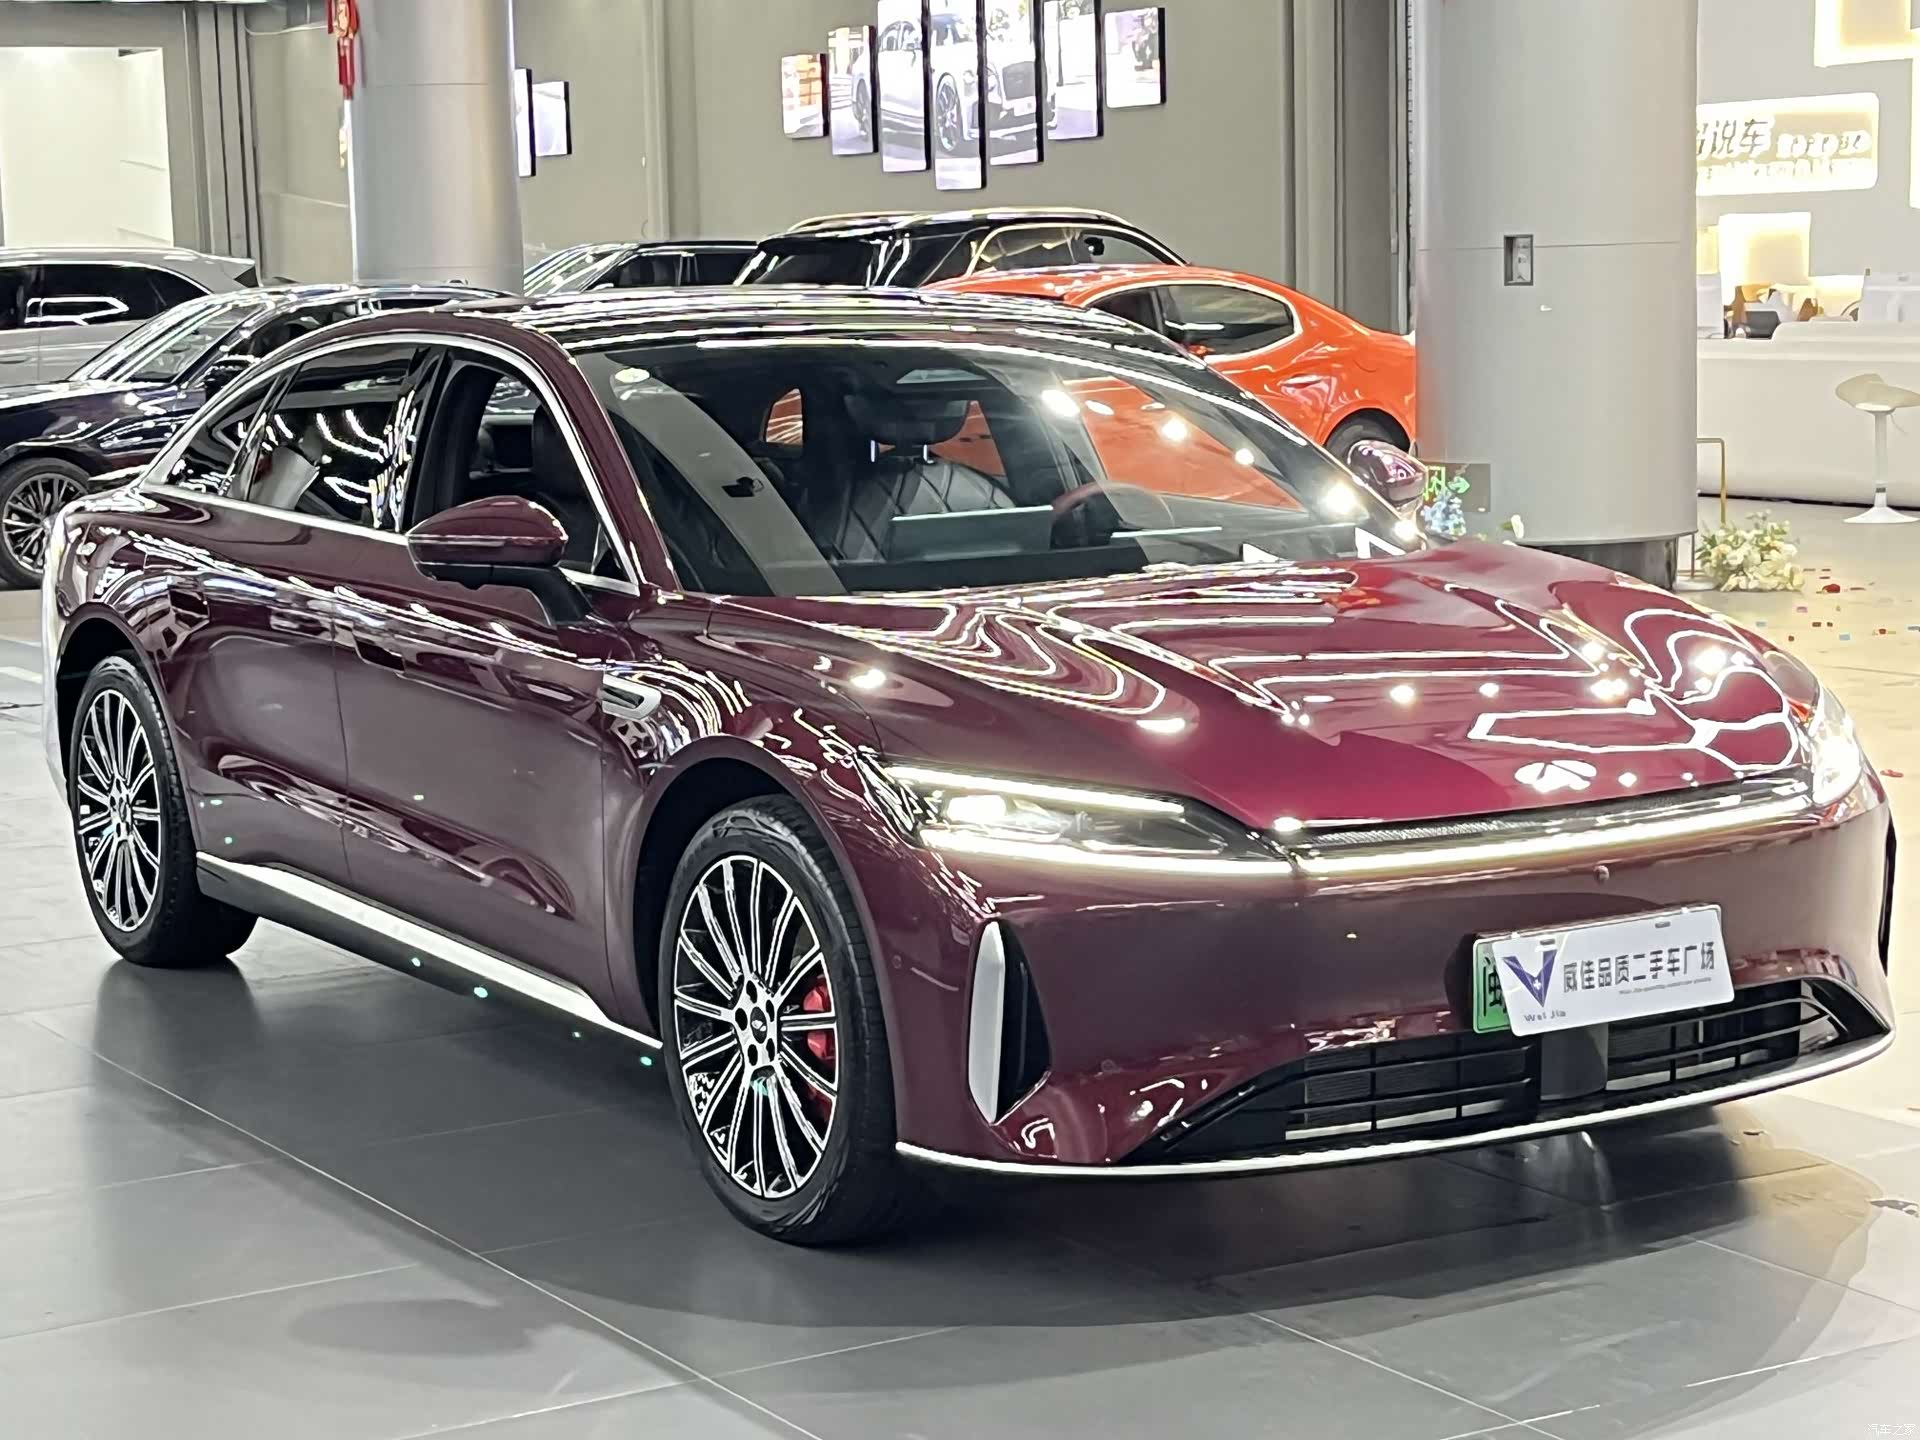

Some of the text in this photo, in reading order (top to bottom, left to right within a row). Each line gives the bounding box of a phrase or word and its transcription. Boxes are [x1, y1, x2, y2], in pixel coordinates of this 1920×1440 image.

[1563, 941, 1715, 993] 威佳品质二手车广场
